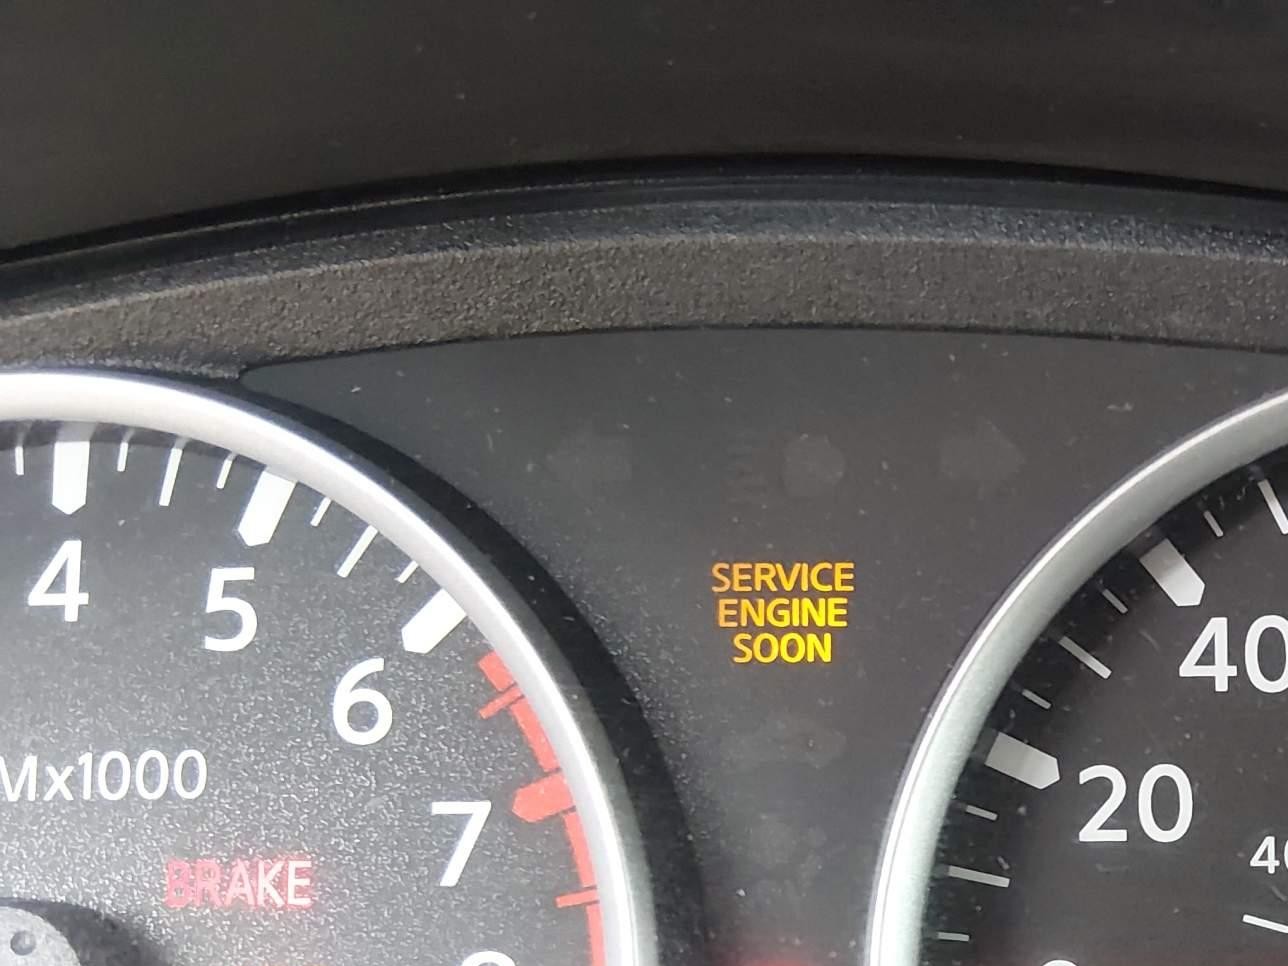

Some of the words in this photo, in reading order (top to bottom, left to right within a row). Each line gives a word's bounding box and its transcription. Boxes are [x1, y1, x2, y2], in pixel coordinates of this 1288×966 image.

[27, 540, 89, 622] 4
[203, 567, 258, 651] 5
[711, 562, 855, 593] SERVICE
[718, 598, 848, 629] ENGINE
[732, 633, 832, 664] SOON
[332, 658, 393, 745] 6
[1078, 764, 1194, 843] 20
[165, 858, 313, 908] BRAKE
[431, 801, 491, 887] 7
